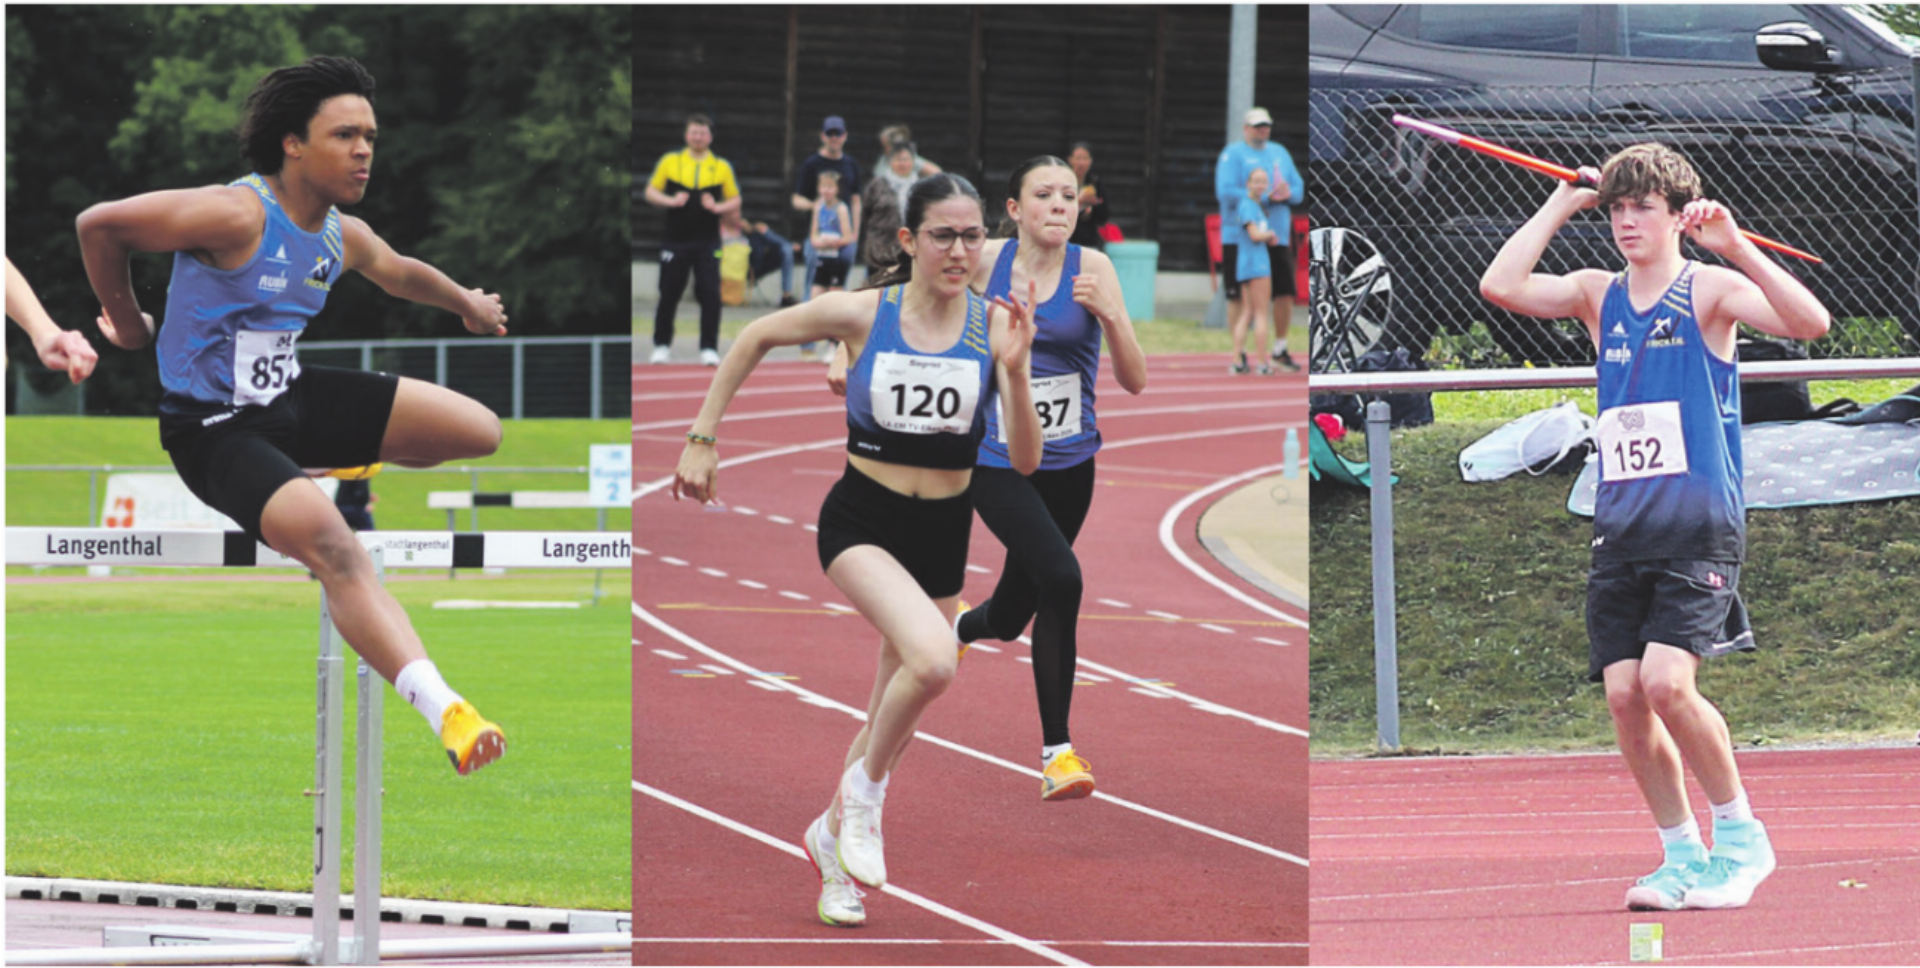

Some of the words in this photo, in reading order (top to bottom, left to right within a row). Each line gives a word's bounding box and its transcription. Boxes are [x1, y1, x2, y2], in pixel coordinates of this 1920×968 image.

[890, 383, 962, 419] 120
[1615, 437, 1664, 472] 152
[607, 482, 620, 502] 2
[46, 533, 163, 560] Langenthal
[542, 538, 631, 563] Langenth
